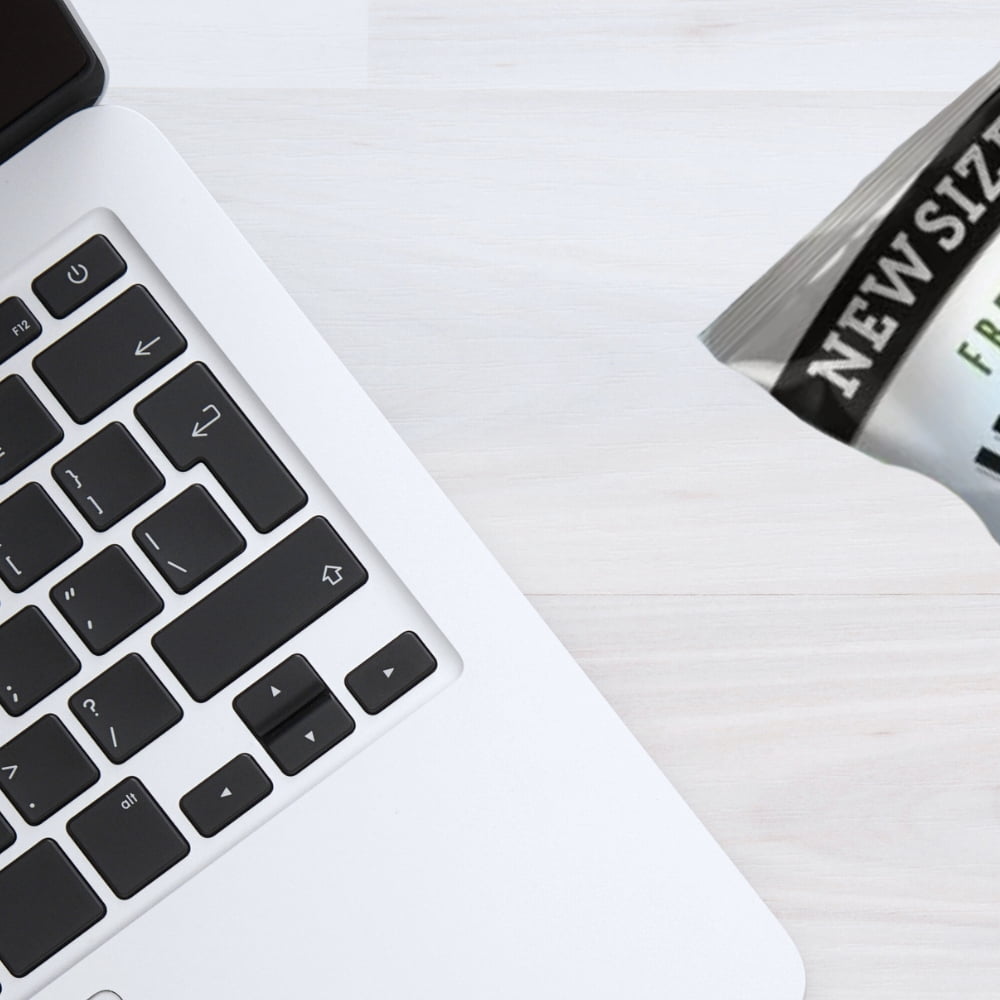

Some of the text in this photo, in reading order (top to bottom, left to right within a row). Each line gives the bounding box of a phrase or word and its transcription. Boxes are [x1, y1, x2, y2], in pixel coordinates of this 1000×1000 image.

[807, 232, 934, 399] NEW
[11, 319, 31, 337] F12
[121, 792, 138, 810] alt
